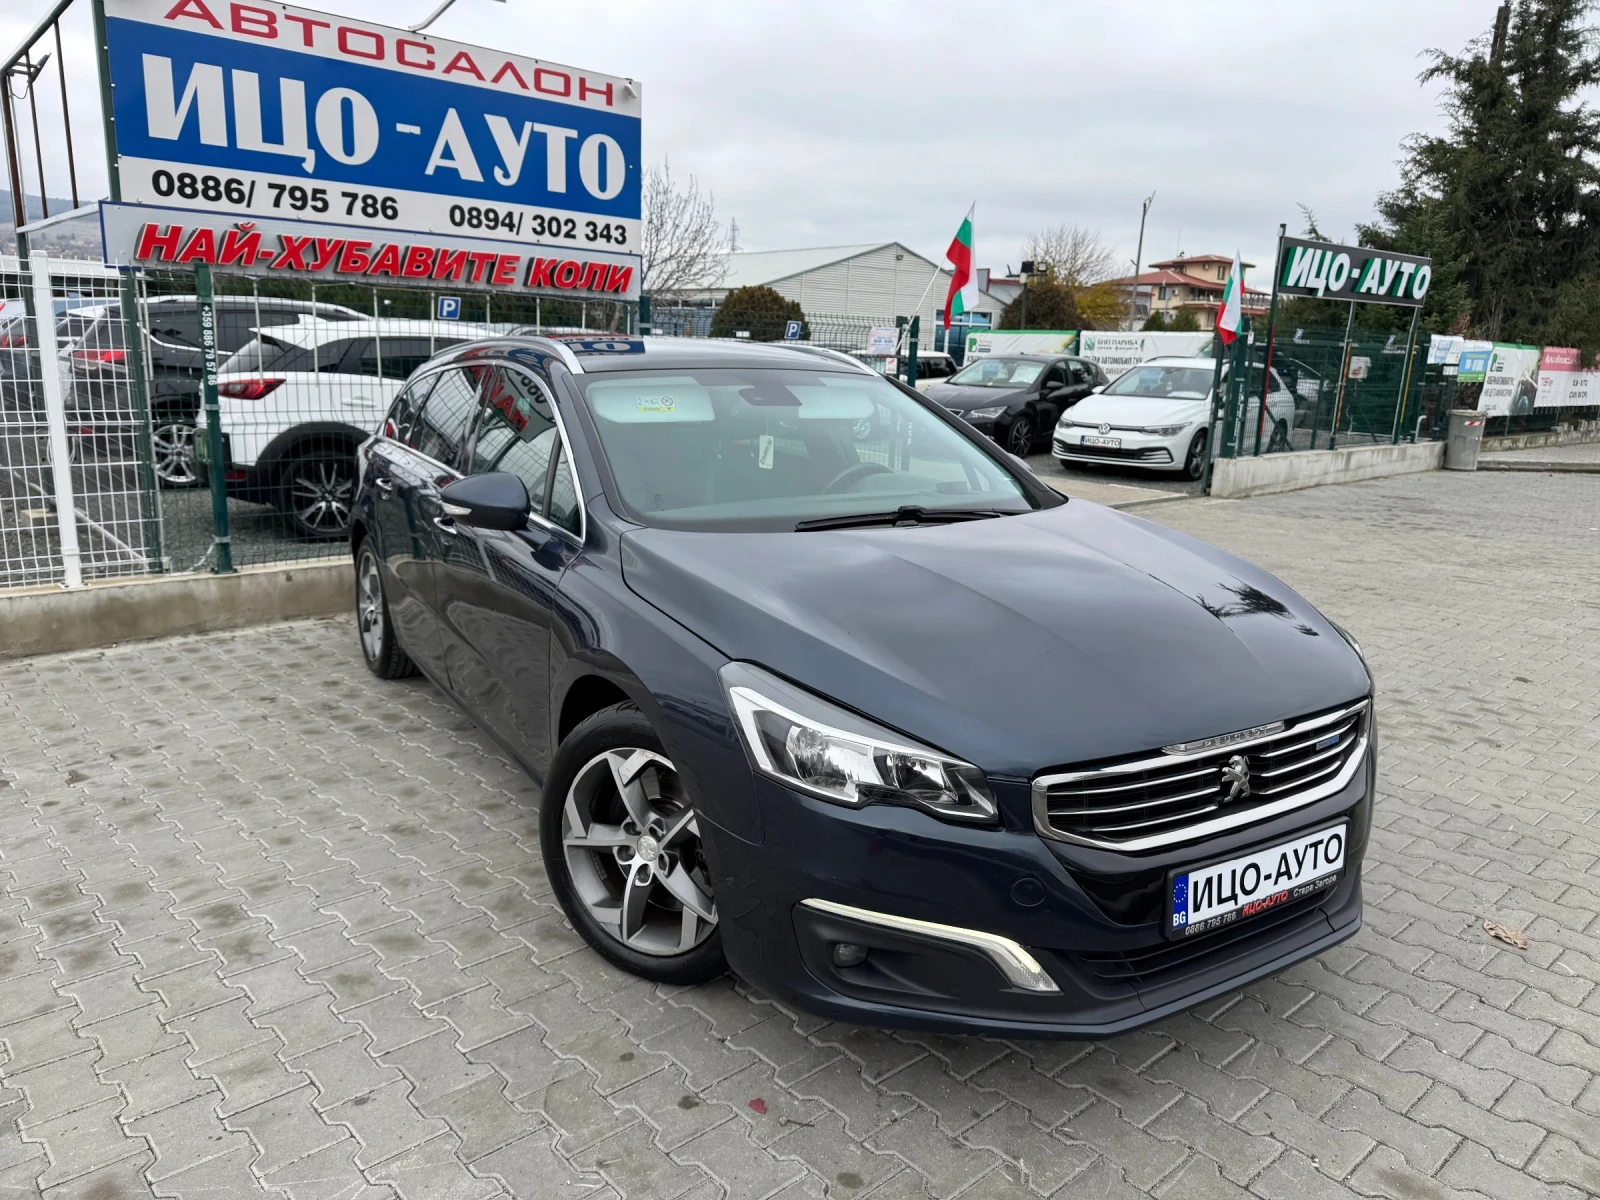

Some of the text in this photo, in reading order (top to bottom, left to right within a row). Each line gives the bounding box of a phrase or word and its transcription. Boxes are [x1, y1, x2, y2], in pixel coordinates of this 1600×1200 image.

[164, 0, 613, 107] АВТОСАЛОН
[152, 169, 399, 220] 0886/ 795 786
[449, 204, 627, 245] 0894/ 302 343
[136, 222, 634, 294] НАЙ-ХУБАВИТЕ КОЛИ
[1285, 246, 1432, 300] ИЦО-АУТО
[203, 329, 214, 347] 886
[205, 348, 216, 360] 79
[206, 361, 217, 372] 57
[1192, 833, 1343, 914] ИЦО-АУТО
[1172, 910, 1186, 927] BG
[1185, 874, 1337, 936] 0886 795 786 ИЦО-АУТО Стара Загора
